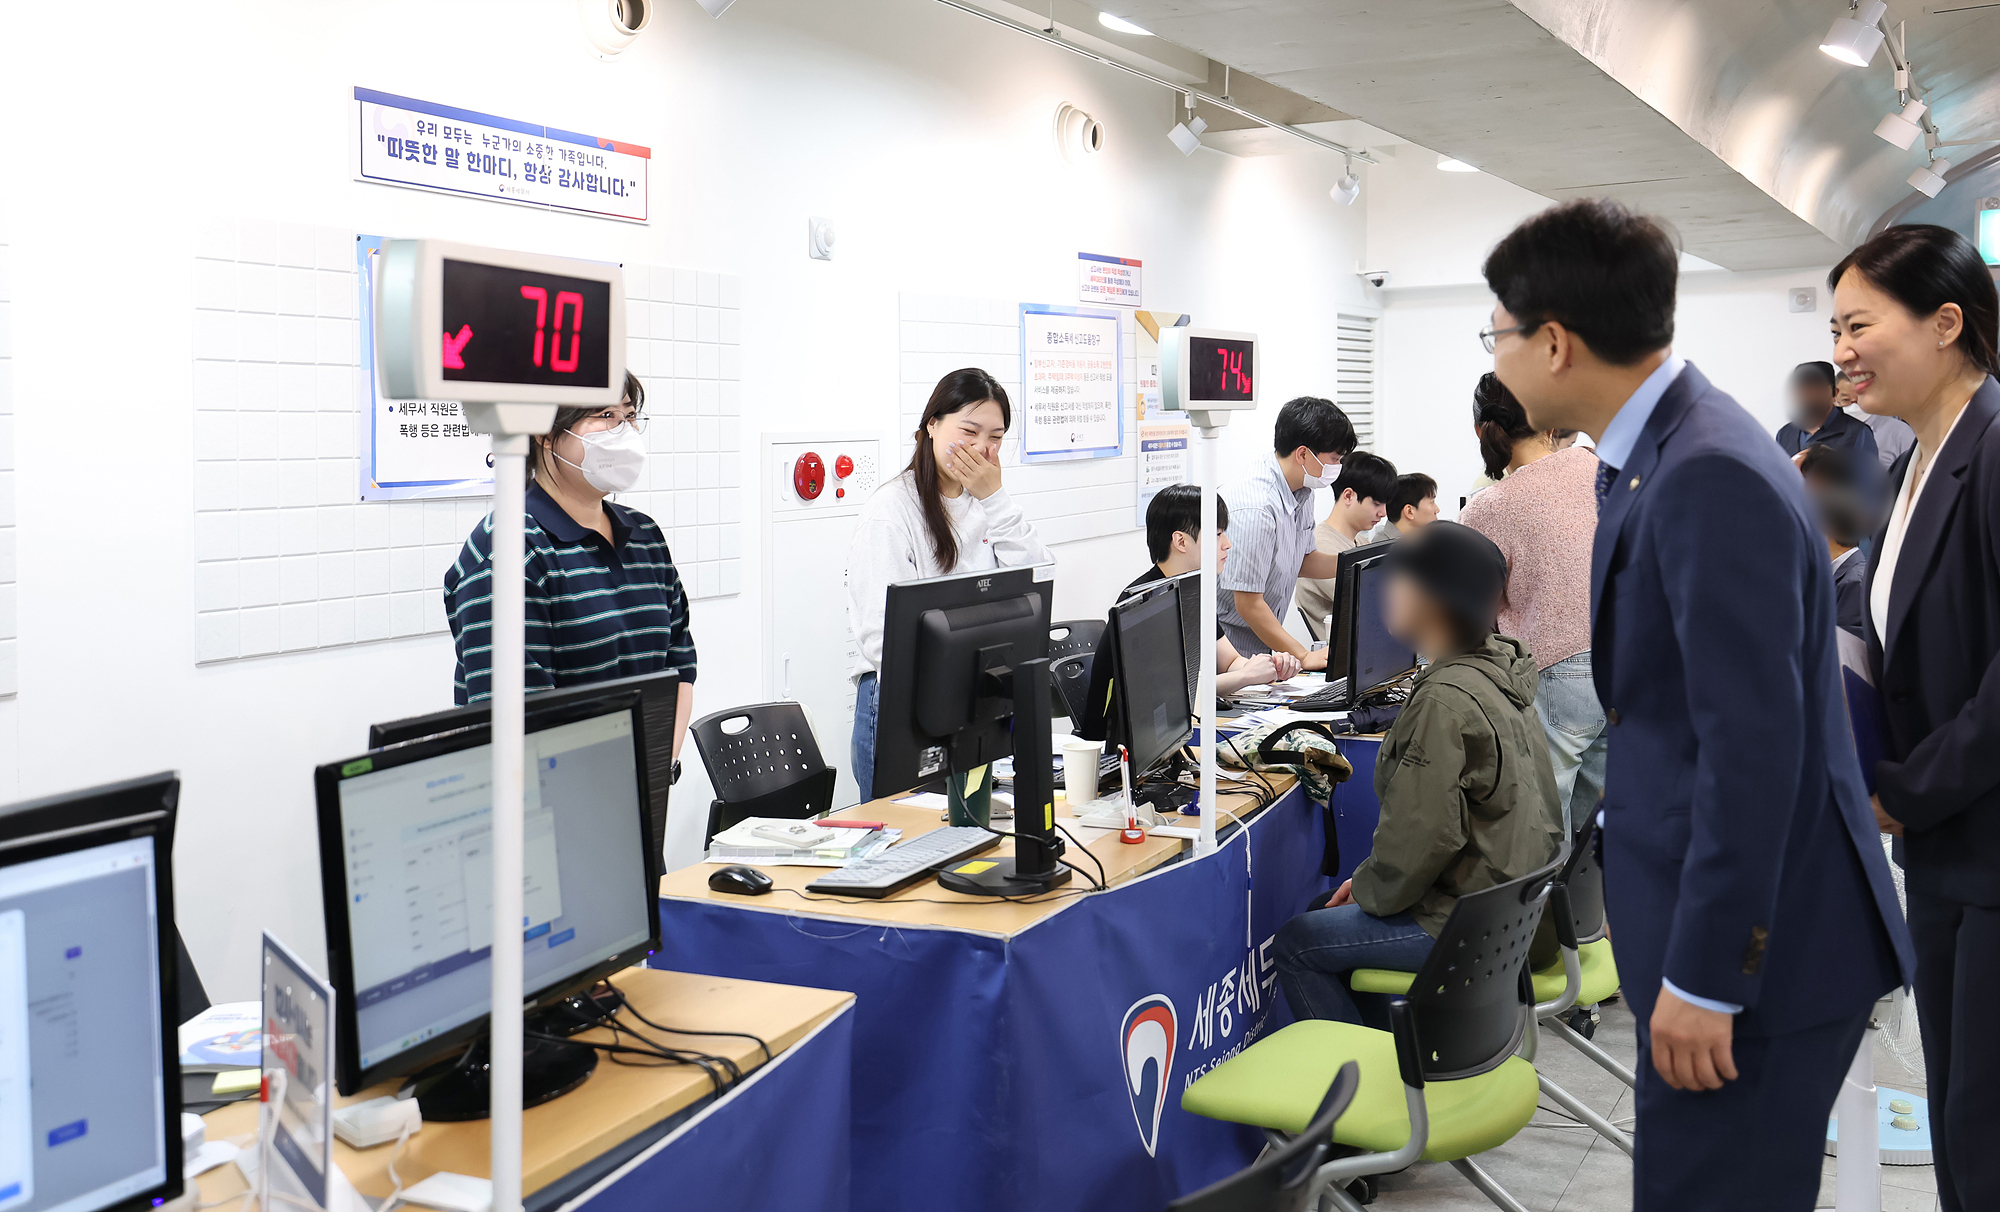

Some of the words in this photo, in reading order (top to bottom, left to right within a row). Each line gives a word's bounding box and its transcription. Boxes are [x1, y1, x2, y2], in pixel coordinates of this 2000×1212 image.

[377, 134, 438, 166] "따뜻한
[445, 146, 460, 170] 말
[466, 150, 518, 181] 한마디,
[524, 161, 553, 185] 항상
[558, 167, 636, 198] 감사합니다."
[416, 119, 438, 137] 우리
[443, 125, 473, 146] 모두는
[482, 132, 522, 153] 누군가의
[526, 142, 554, 161] 소중한
[558, 148, 607, 170] 가족입니다.
[520, 285, 584, 373] 70
[1217, 348, 1243, 391] 74
[398, 402, 427, 417] 세무서
[430, 402, 459, 417] 직원은
[399, 424, 418, 439] 폭행
[421, 424, 440, 439] 등은
